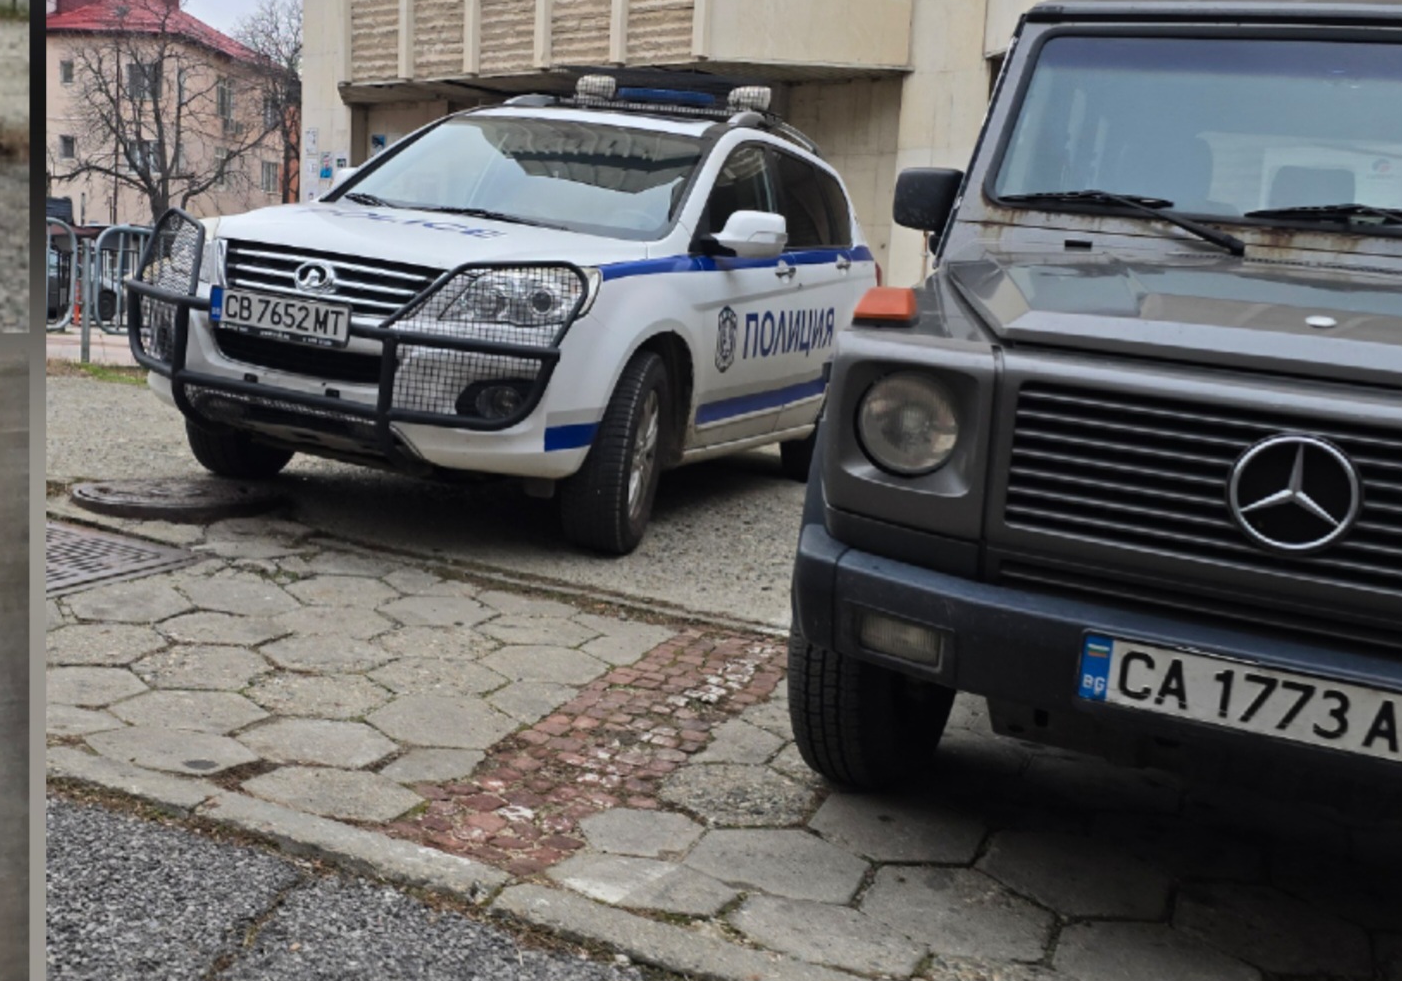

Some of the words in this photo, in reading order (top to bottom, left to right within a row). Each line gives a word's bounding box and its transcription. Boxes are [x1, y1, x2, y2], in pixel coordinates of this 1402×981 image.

[257, 299, 310, 332] 7652
[312, 307, 345, 336] MT
[743, 307, 835, 360] ПОЛИЦИЯ
[1082, 673, 1106, 695] BG
[1117, 650, 1188, 710] CA
[1214, 669, 1351, 740] 1773
